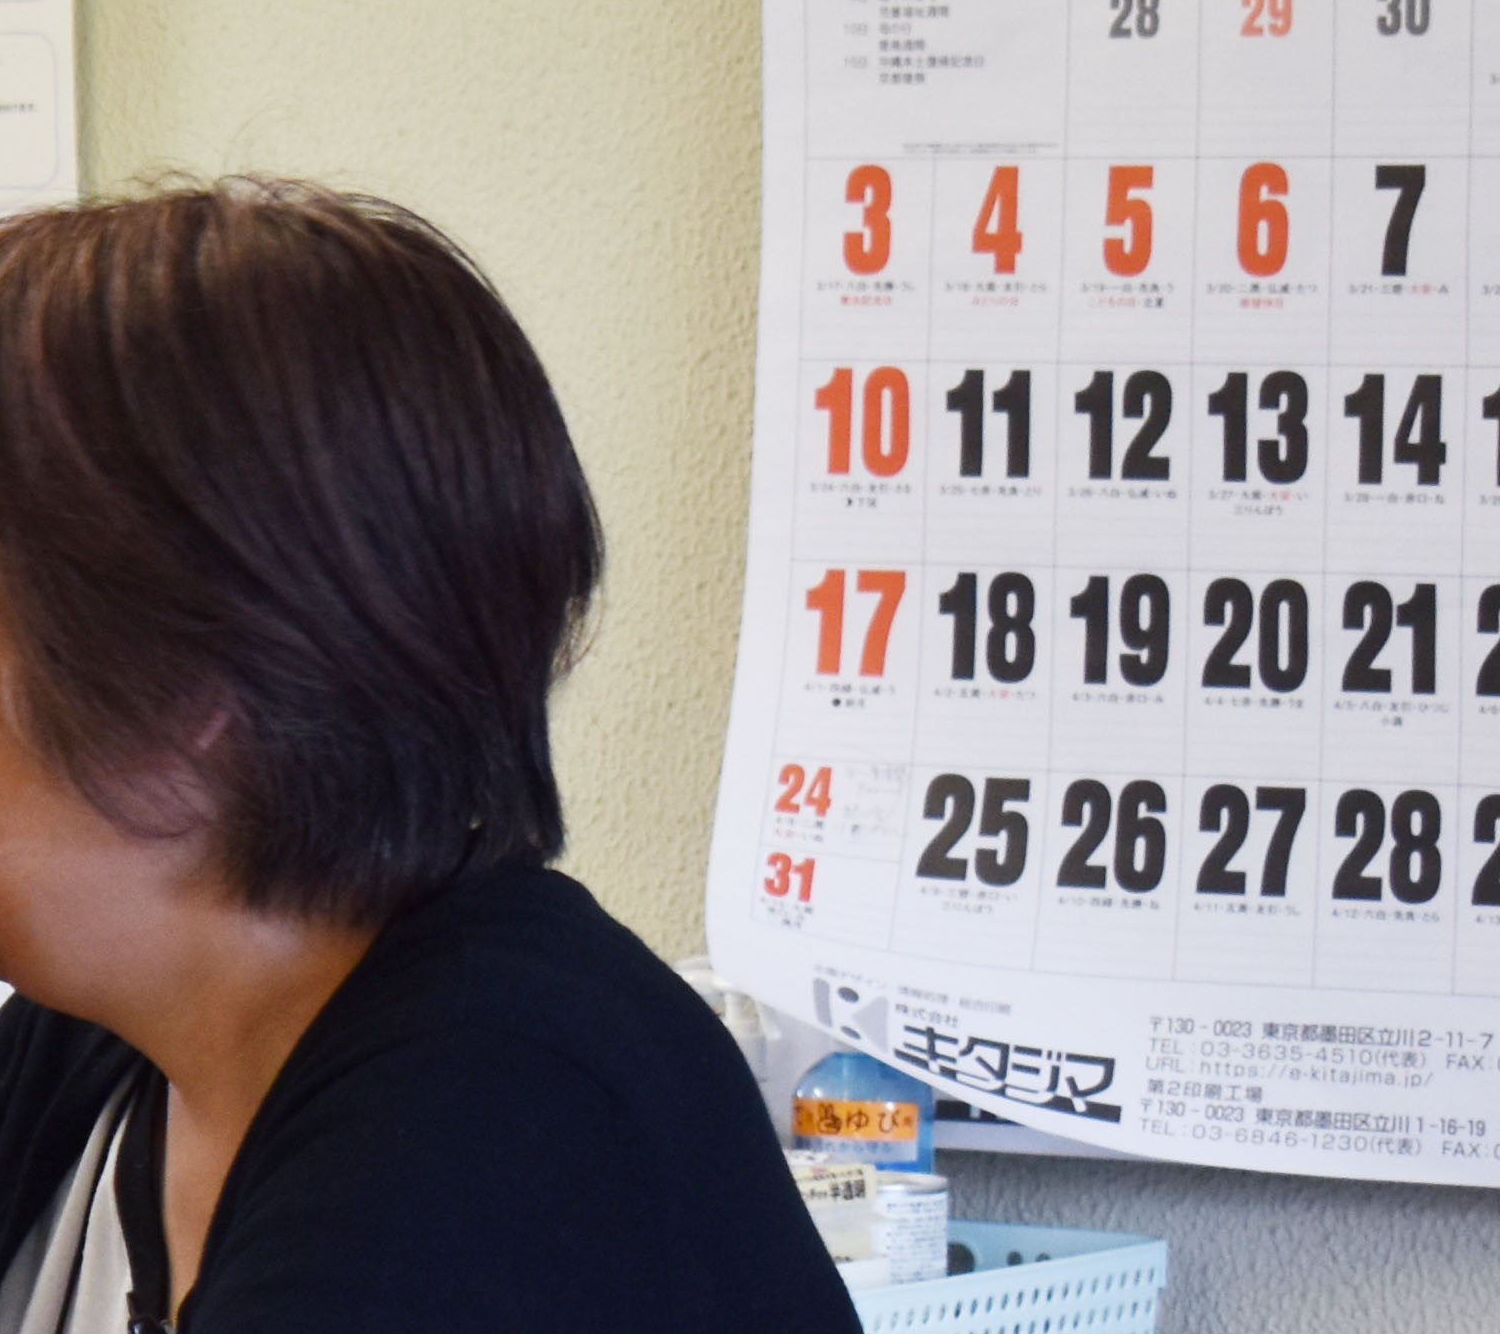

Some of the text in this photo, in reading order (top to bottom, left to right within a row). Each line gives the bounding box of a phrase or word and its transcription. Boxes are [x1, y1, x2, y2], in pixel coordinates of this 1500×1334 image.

[842, 161, 1427, 278] 3 4 5 6 7
[813, 365, 911, 478] 10
[946, 369, 1032, 478] 11
[1073, 370, 1174, 481] 12
[1207, 370, 1309, 485] 13
[1343, 373, 1448, 486] 14
[805, 569, 907, 679] 17
[938, 571, 1037, 683] 18
[1069, 573, 1171, 687] 19
[1201, 577, 1310, 693] 20
[1342, 579, 1438, 696] 21
[763, 851, 816, 903] 31
[774, 763, 833, 818] 24
[915, 772, 1031, 888] 25
[1055, 777, 1168, 895] 26
[1195, 782, 1308, 899] 27
[1331, 787, 1443, 905] 28
[894, 1024, 1122, 1124] キタジマ
[1445, 1053, 1500, 1072] FAX:
